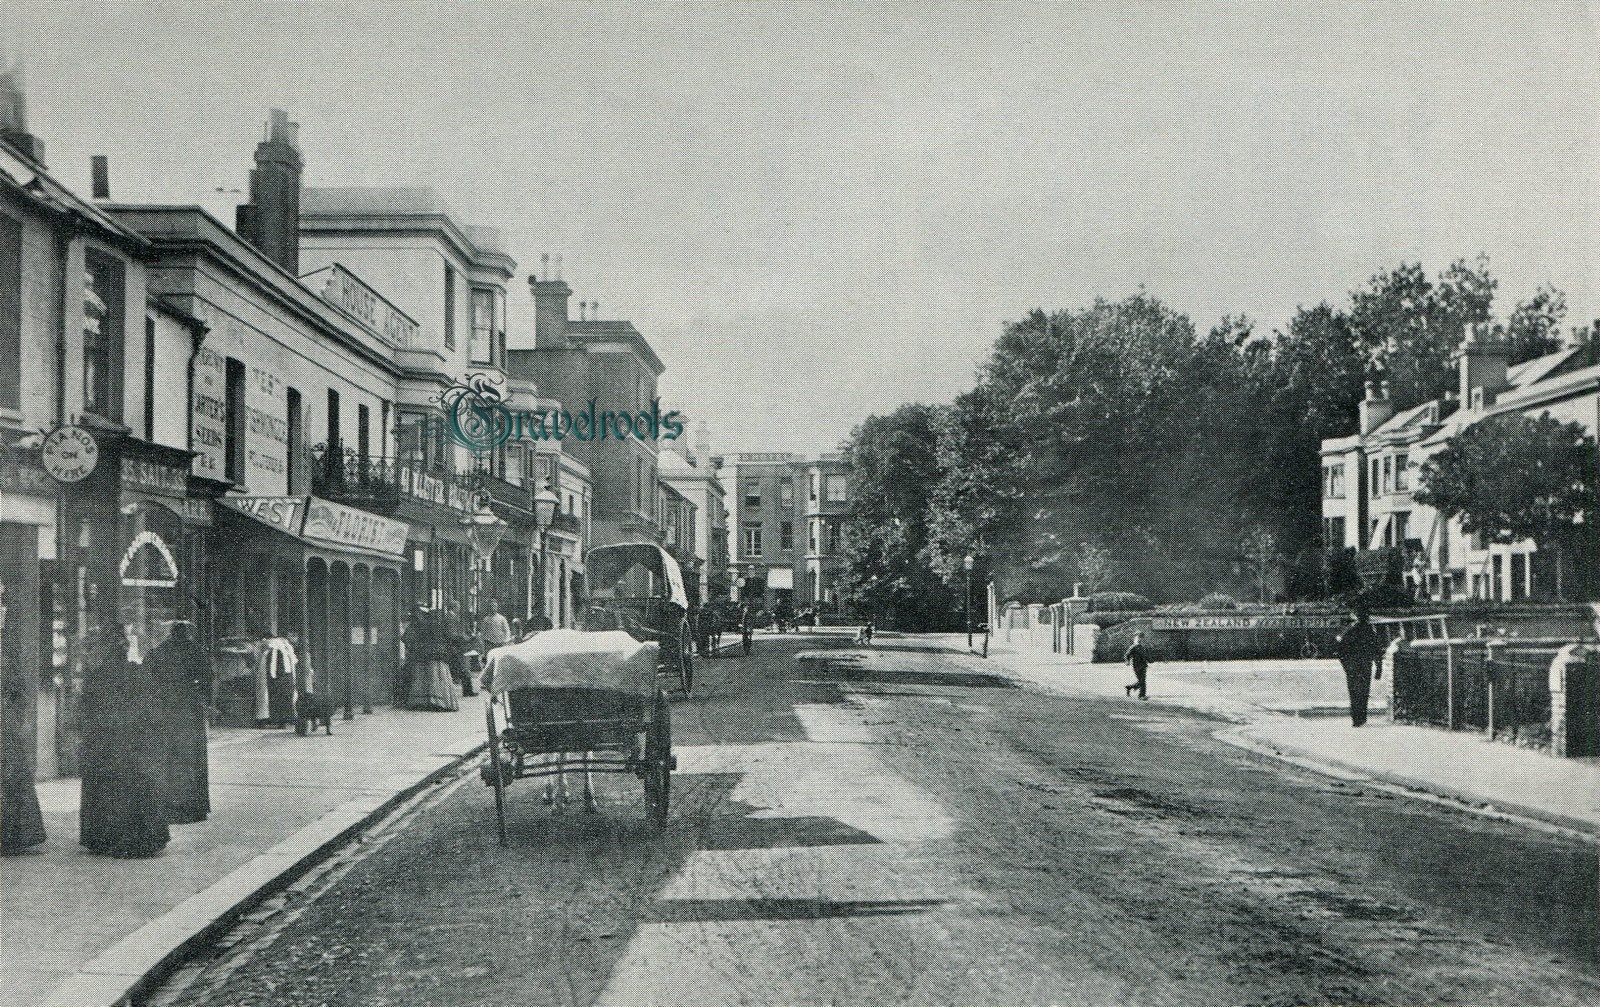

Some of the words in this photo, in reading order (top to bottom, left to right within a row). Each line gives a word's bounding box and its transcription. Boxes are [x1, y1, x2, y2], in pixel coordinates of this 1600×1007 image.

[47, 429, 96, 454] PIANOS
[61, 451, 78, 460] ON
[51, 465, 88, 480] HIRE
[236, 498, 302, 532] WEST
[336, 510, 387, 546] FLORIST
[1163, 618, 1189, 628] NEW
[1194, 617, 1250, 628] ZEALAND
